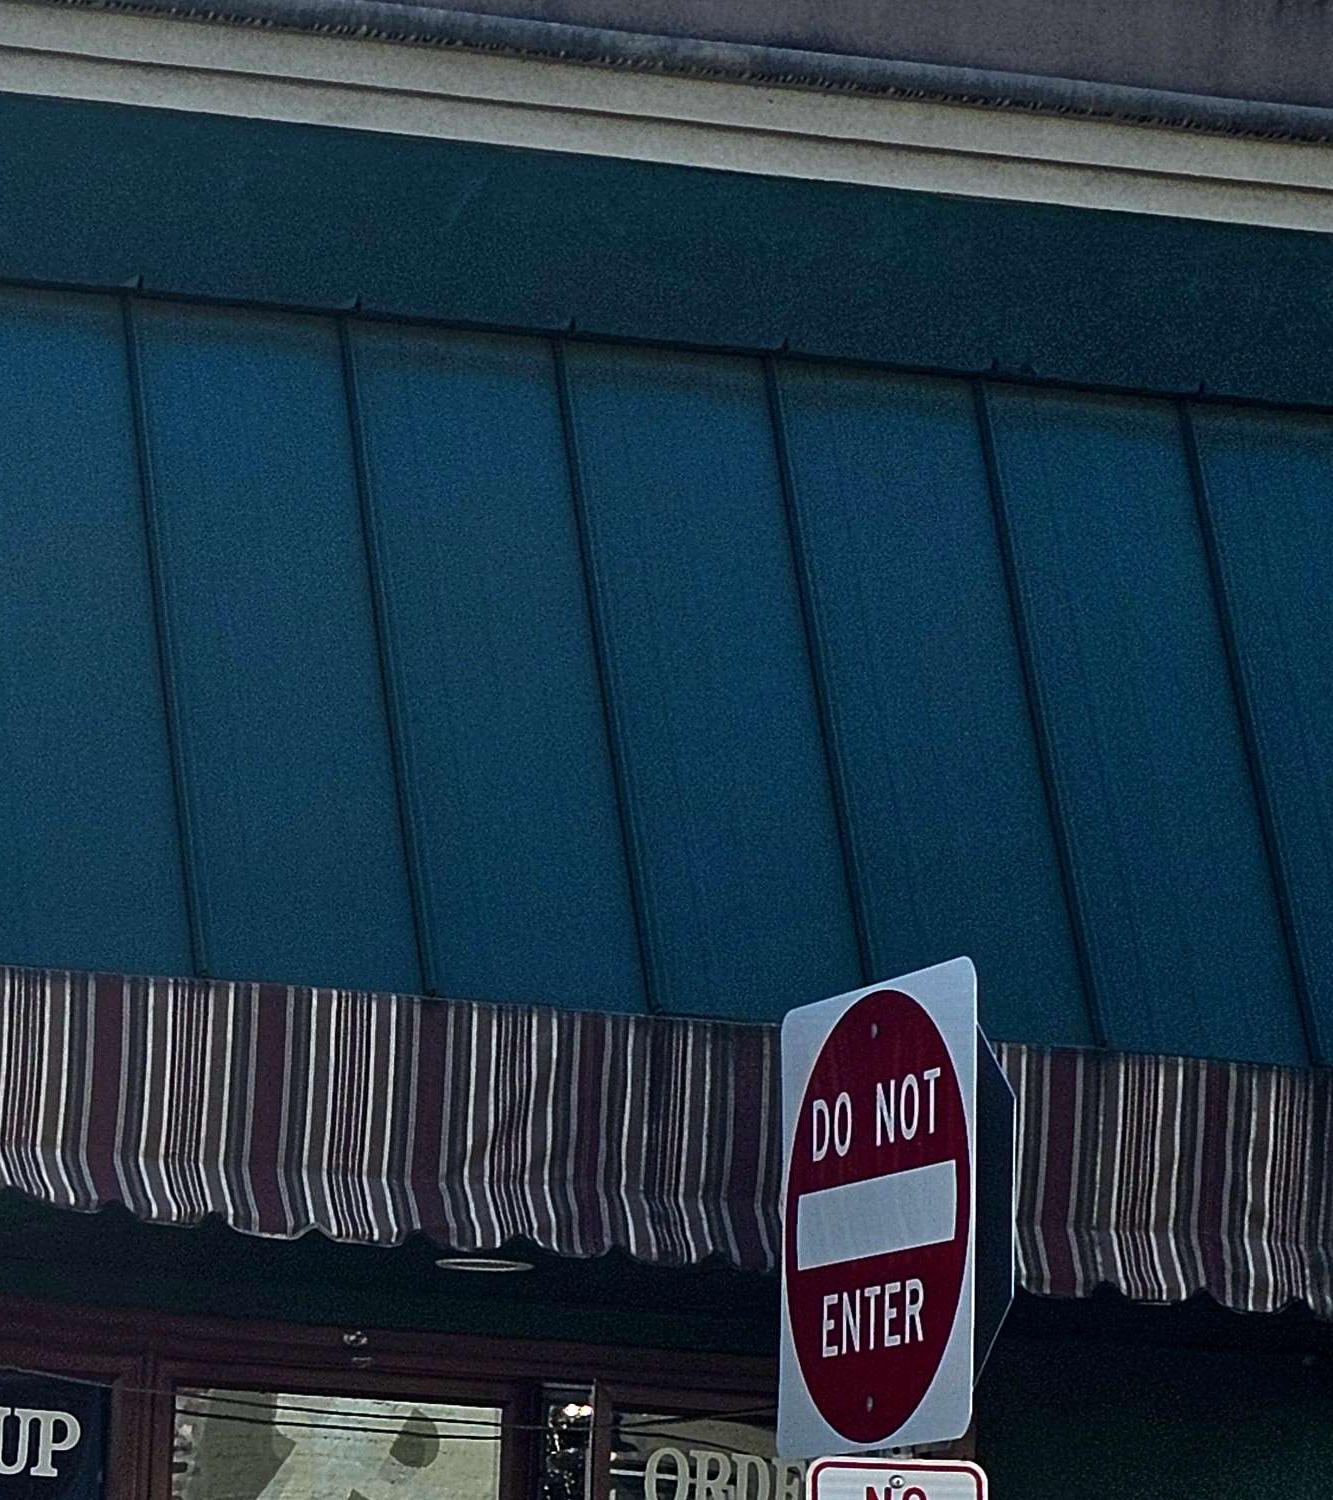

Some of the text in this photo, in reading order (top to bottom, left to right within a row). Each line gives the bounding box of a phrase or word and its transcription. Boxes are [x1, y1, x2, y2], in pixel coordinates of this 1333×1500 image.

[813, 1068, 941, 1162] DO NOT
[822, 1278, 925, 1359] ENTER
